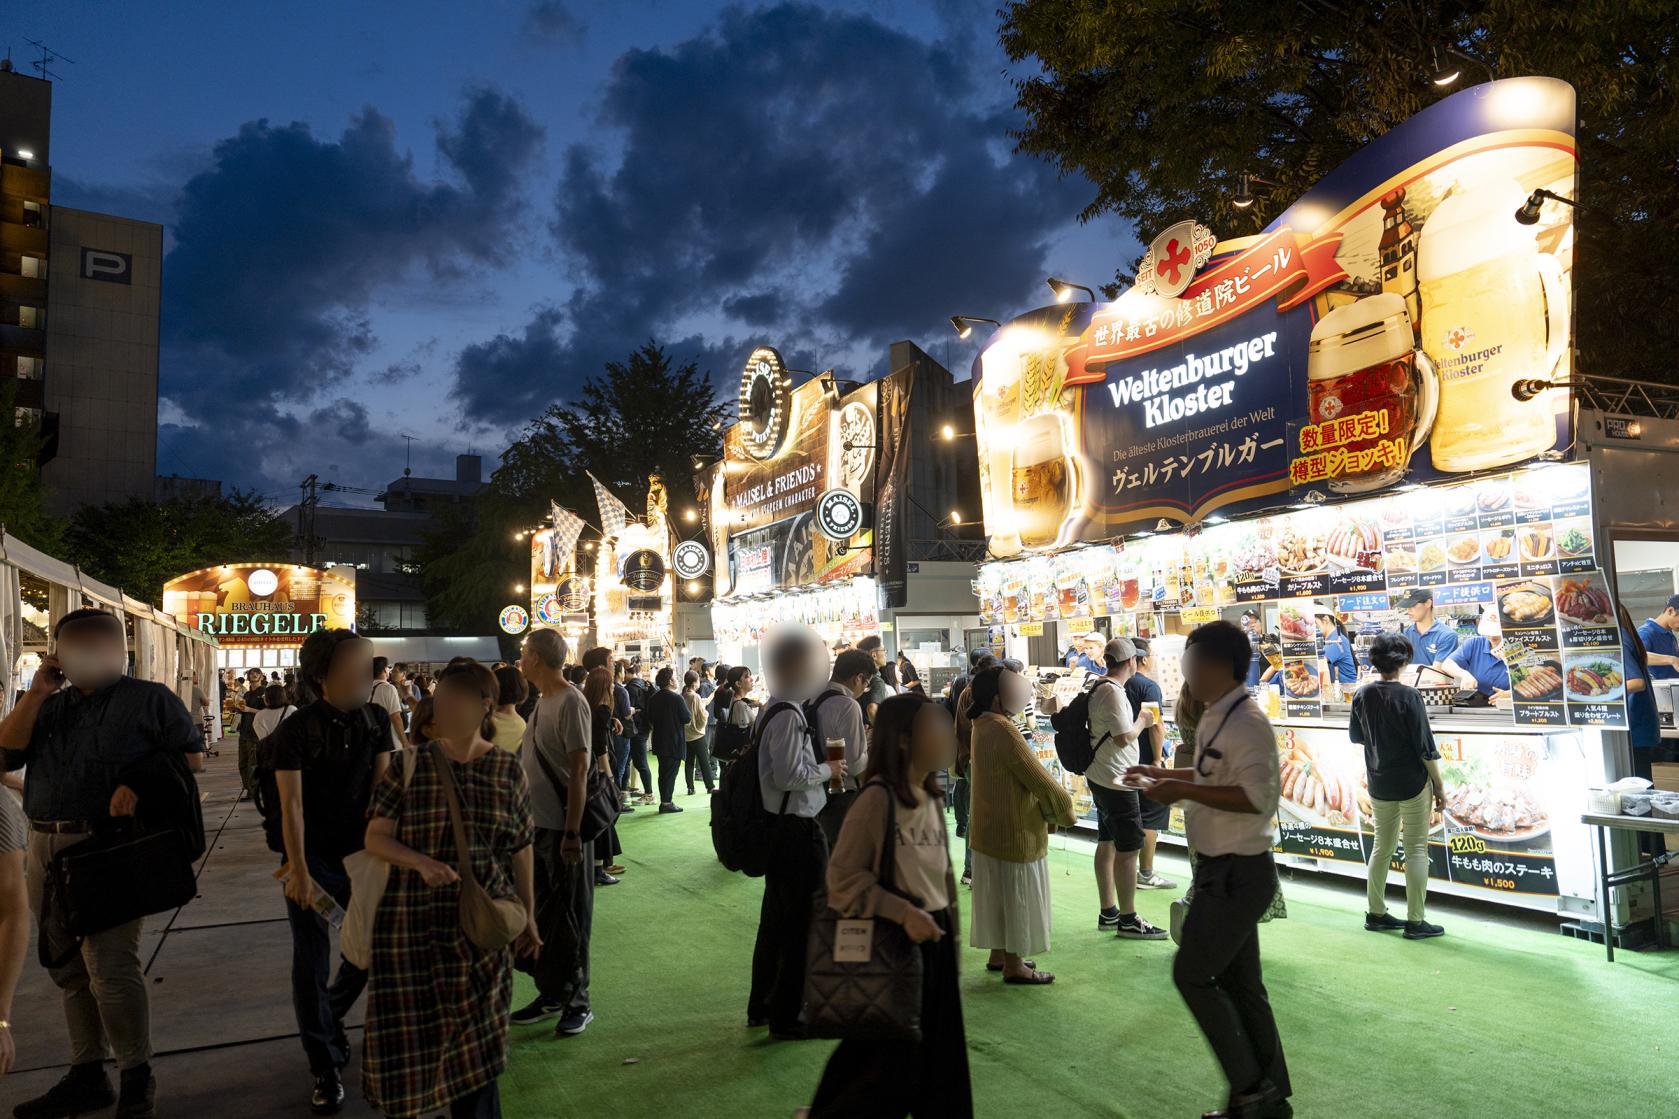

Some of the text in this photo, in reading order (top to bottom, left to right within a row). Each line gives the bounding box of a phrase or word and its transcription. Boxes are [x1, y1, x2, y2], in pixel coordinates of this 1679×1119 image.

[85, 251, 126, 277] P
[1136, 237, 1216, 285] SEIT 1050
[1094, 247, 1292, 347] 世界最古の修道院ビール
[1432, 345, 1503, 371] eltenburger
[1107, 331, 1278, 409] Weltenburger
[1441, 362, 1484, 382] Kloster
[1142, 379, 1235, 428] Kloster
[1112, 407, 1275, 463] Die älteste Klosterbrauerei der Welt
[1112, 431, 1284, 495] ヴェルテンブルガー
[736, 463, 816, 510] MAISEL & FRIENDS
[825, 495, 857, 513] MAISEL
[829, 520, 855, 532] FRIENDS
[1287, 583, 1322, 591] カリーブルスト
[1332, 574, 1384, 585] ソーセージ8本盛合せ
[1237, 584, 1279, 595] 牛もも肉のステーキ
[1434, 585, 1490, 599] フード提供口
[231, 601, 296, 611] BRAUHAUS
[1339, 595, 1386, 606] フード注文口
[1519, 710, 1560, 718] ブラートブルスト
[1285, 728, 1296, 750] 3
[1454, 736, 1465, 762] 1
[1280, 821, 1312, 831] 特選4種の
[1282, 832, 1360, 851] ソーセージ8本盛合せ
[1450, 837, 1485, 852] 120g
[1309, 847, 1335, 857] ¥1,900
[1451, 855, 1554, 879] 牛もも肉のステーキ
[1484, 878, 1515, 889] ¥1,500
